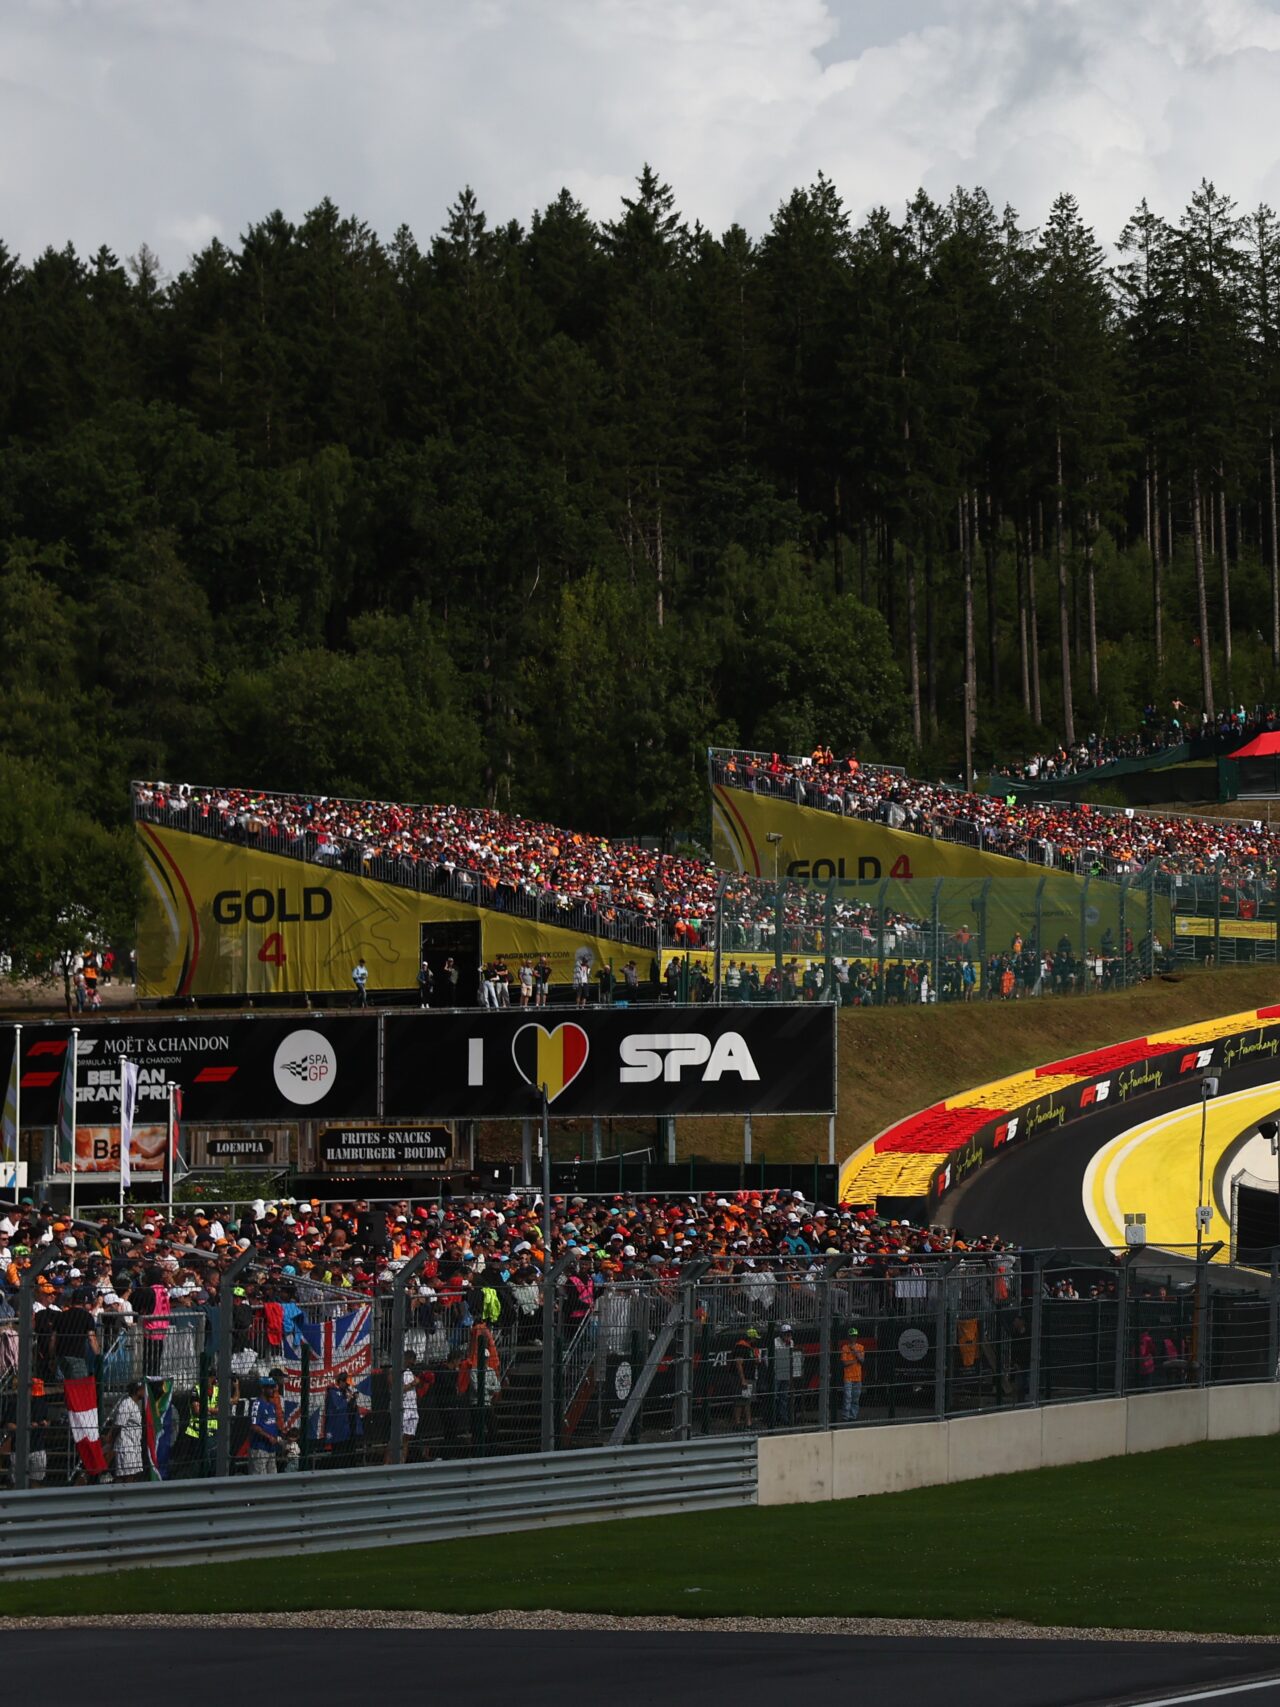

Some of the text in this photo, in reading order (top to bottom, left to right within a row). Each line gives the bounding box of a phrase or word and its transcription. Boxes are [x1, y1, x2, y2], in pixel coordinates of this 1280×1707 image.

[787, 854, 912, 888] GOLD 4
[213, 887, 332, 924] GOLD
[258, 932, 286, 967] 4
[104, 1036, 229, 1053] MOËT & CHANDON
[308, 1054, 328, 1064] SPA
[468, 1032, 760, 1086] I SPA
[88, 1069, 165, 1085] BELAN
[308, 1066, 328, 1081] GP
[342, 1132, 380, 1144] FRITES
[388, 1131, 431, 1144] SNACKS
[94, 1139, 132, 1159] Ba
[216, 1142, 264, 1153] LOEMPIA
[327, 1147, 396, 1160] HAMBURGER
[404, 1147, 446, 1158] BOUDIN
